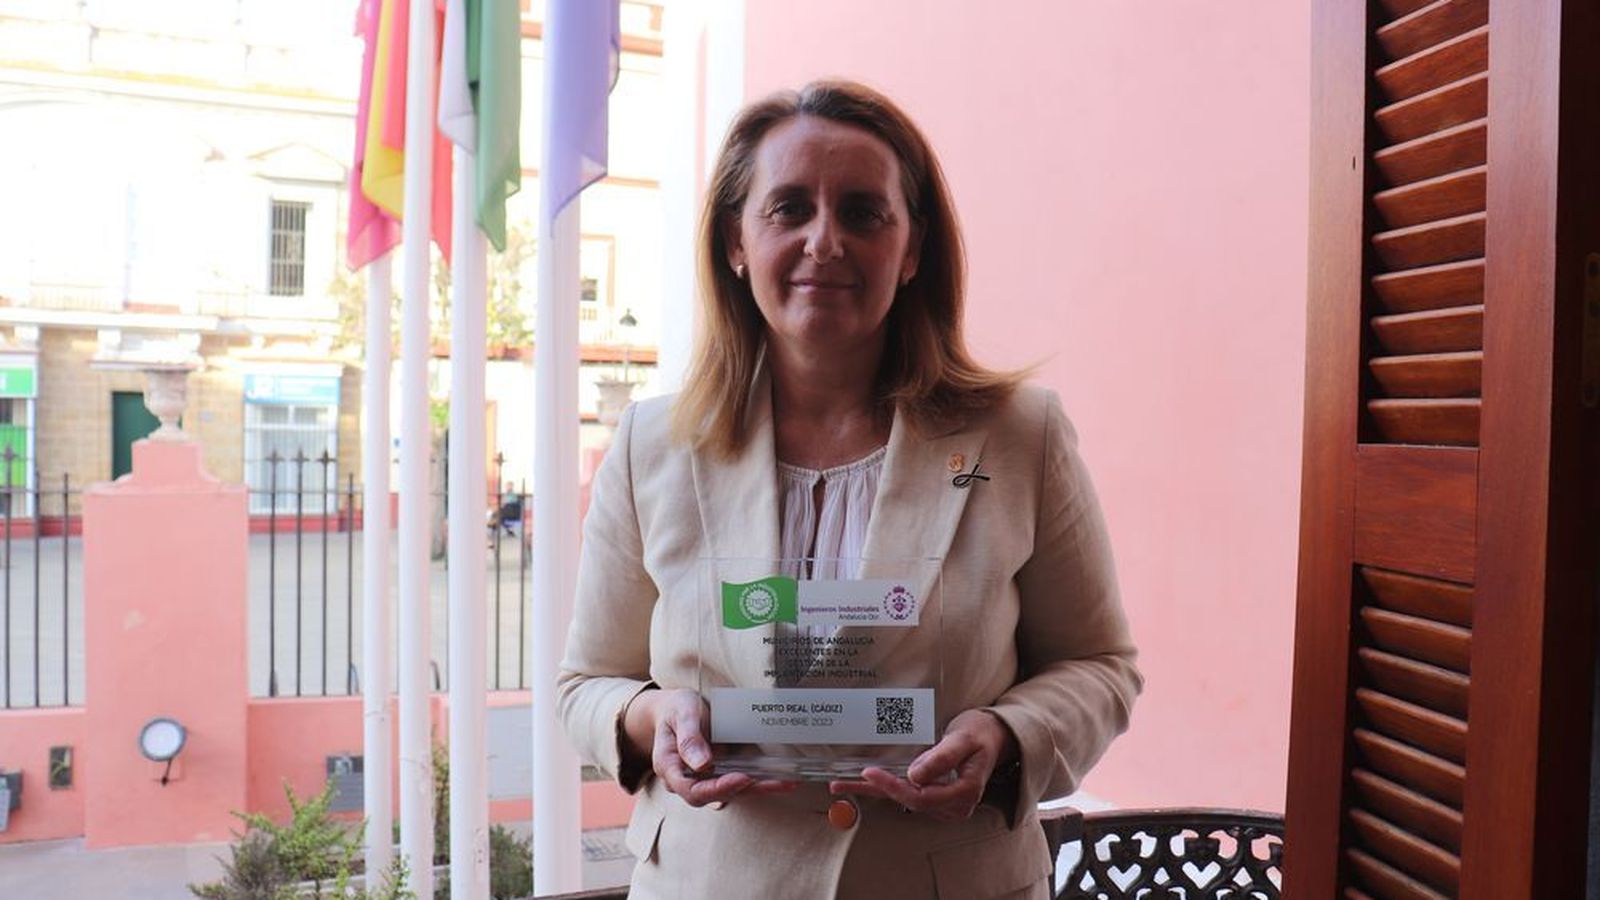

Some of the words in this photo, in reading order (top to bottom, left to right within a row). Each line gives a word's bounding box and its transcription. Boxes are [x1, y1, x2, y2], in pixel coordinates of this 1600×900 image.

[801, 605, 837, 614] Ingenieros
[839, 605, 879, 613] Industriales
[763, 637, 811, 645] MUNICIPIOS
[814, 637, 825, 645] DE
[779, 648, 831, 656] EXCELENTES
[834, 648, 846, 656] EN
[848, 648, 858, 656] LA
[826, 659, 837, 667] DE
[839, 659, 849, 667] LA
[828, 670, 877, 678] INDUSTRIAL
[752, 704, 784, 713] PUERTO
[787, 704, 808, 713] REAL
[811, 718, 833, 726] 2023
